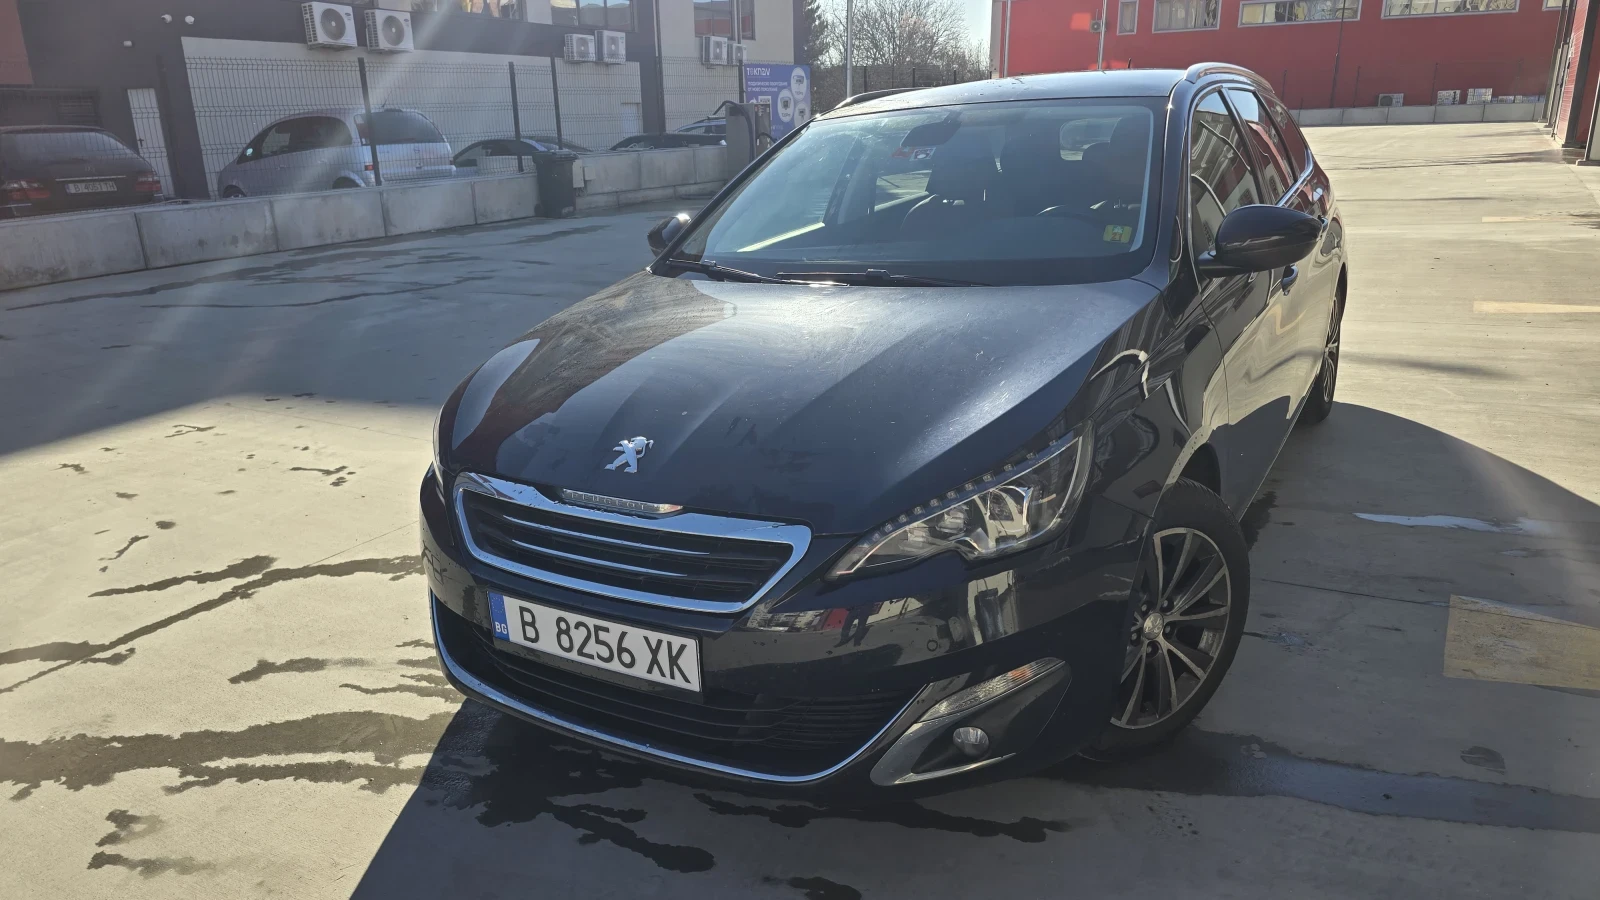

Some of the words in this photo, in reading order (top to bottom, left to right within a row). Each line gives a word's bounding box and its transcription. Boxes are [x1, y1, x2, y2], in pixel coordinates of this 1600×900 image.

[571, 491, 648, 510] PEUGEOT
[494, 621, 508, 635] BG
[518, 605, 540, 644] B
[555, 616, 636, 669] 8256
[642, 635, 692, 684] XK
